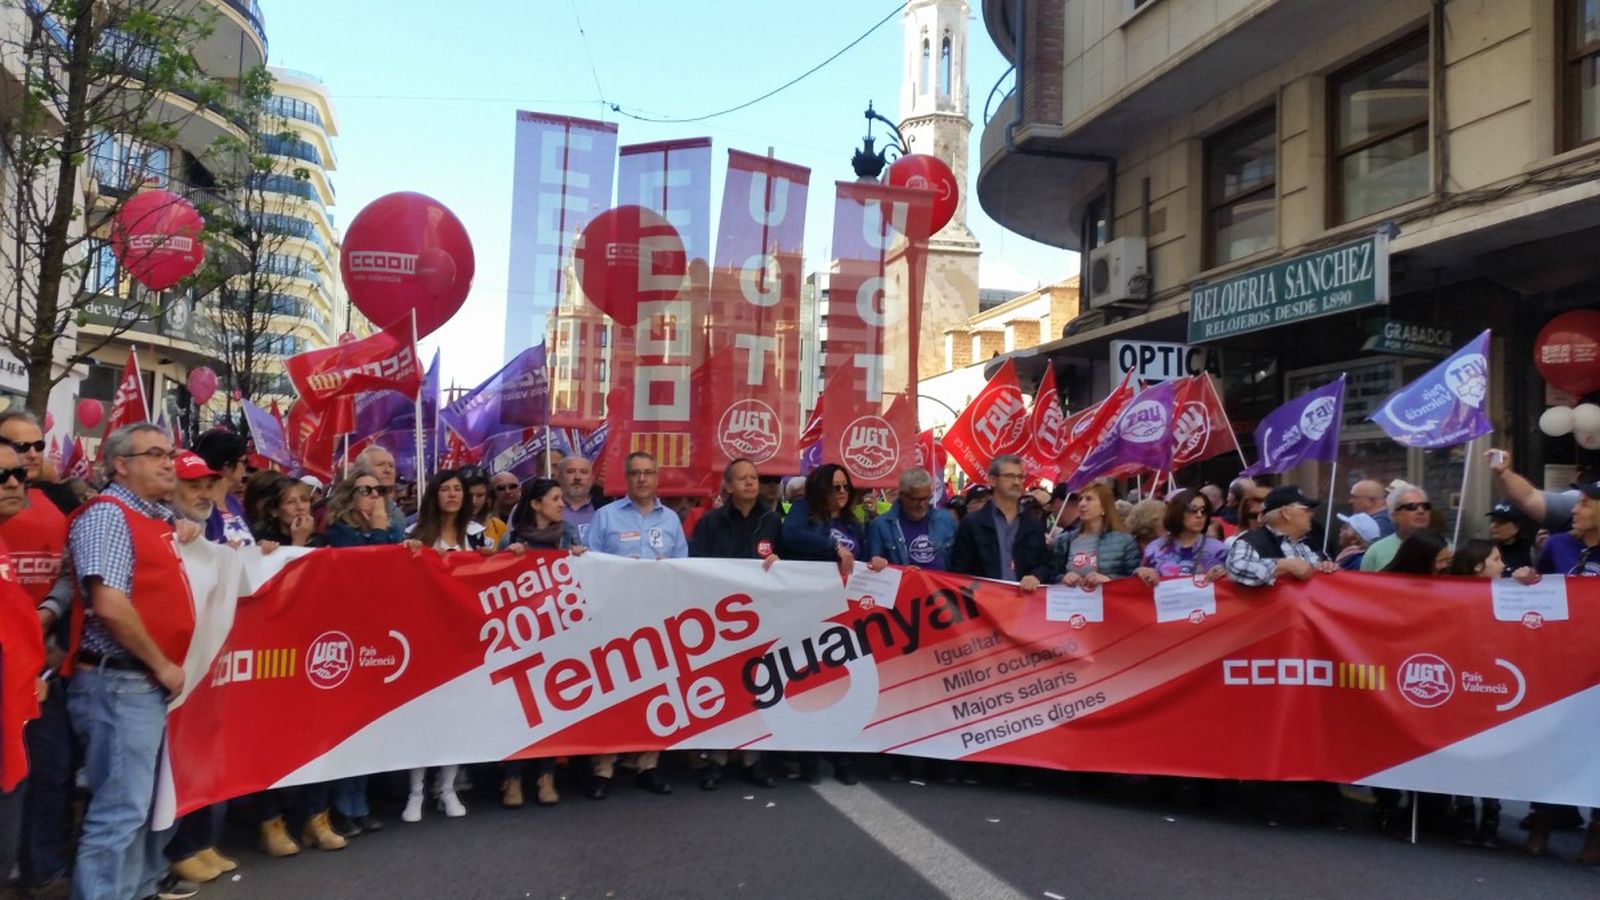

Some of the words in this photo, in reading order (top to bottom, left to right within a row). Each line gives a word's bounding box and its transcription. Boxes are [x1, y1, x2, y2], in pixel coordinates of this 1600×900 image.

[735, 171, 790, 386] UGT
[1192, 272, 1277, 323] RELOJERIA
[1285, 242, 1374, 300] SANCHEZ
[854, 198, 909, 403] UGT
[1205, 308, 1270, 337] RELOJEROS
[1275, 297, 1317, 321] DESDE
[1119, 344, 1222, 378] OPTICA
[728, 409, 772, 434] UGT
[849, 426, 889, 450] UGT
[478, 556, 579, 615] maig
[479, 583, 592, 664] 2018
[312, 641, 348, 663] UGT
[489, 593, 760, 729] Temps
[645, 672, 726, 737] de
[741, 580, 981, 710] guanyar
[934, 630, 1004, 666] Igualtat
[942, 666, 992, 693] Millor
[1223, 659, 1333, 687] CCOO
[1405, 663, 1447, 685] UGT
[1461, 671, 1483, 683] País
[1461, 682, 1508, 694] Valencià
[951, 690, 1015, 721] Majors
[1018, 671, 1078, 700] salaris
[961, 713, 1045, 749] Pensions
[1048, 691, 1107, 721] dignes
